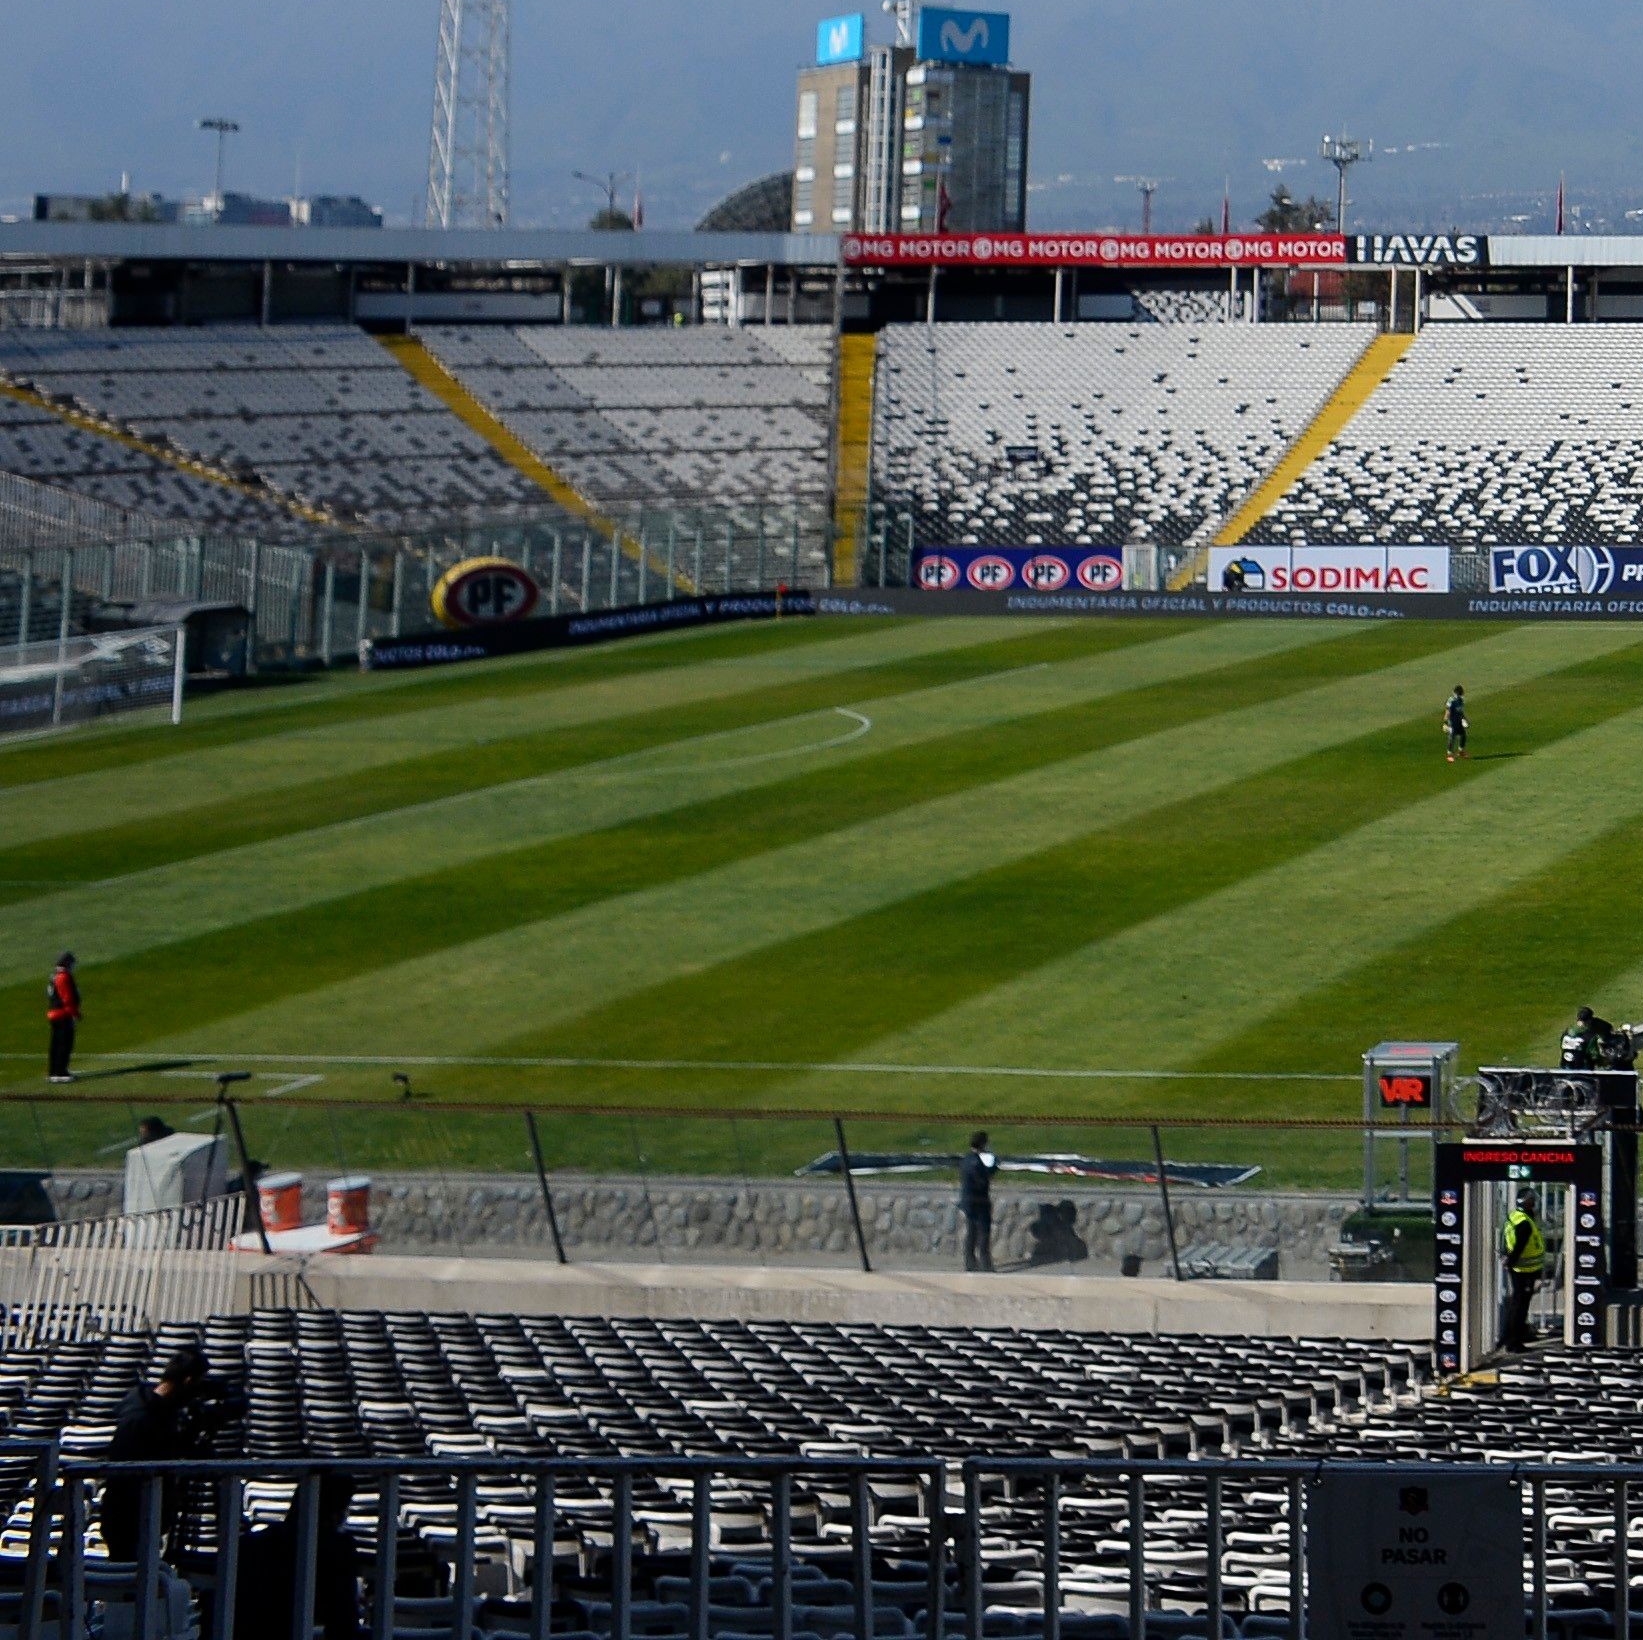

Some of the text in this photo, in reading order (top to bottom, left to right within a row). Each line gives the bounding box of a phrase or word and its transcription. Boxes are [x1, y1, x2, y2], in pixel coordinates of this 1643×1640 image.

[863, 240, 894, 258] MG
[900, 240, 971, 258] MOTOR
[993, 240, 1025, 258] MG
[1029, 240, 1099, 258] MOTOR
[1119, 241, 1150, 258] MG
[1155, 242, 1223, 259] MOTOR
[1244, 241, 1273, 257] MG
[1278, 240, 1345, 258] MOTOR
[1357, 235, 1477, 262] HAVAS
[1494, 547, 1577, 586] FOX
[1271, 566, 1429, 590] SODIMAC
[1468, 600, 1603, 613] INDUMENTARIA
[1463, 1151, 1574, 1163] INGRESO CANCHA
[1398, 1527, 1429, 1543] NO
[1381, 1548, 1447, 1565] PASAR
